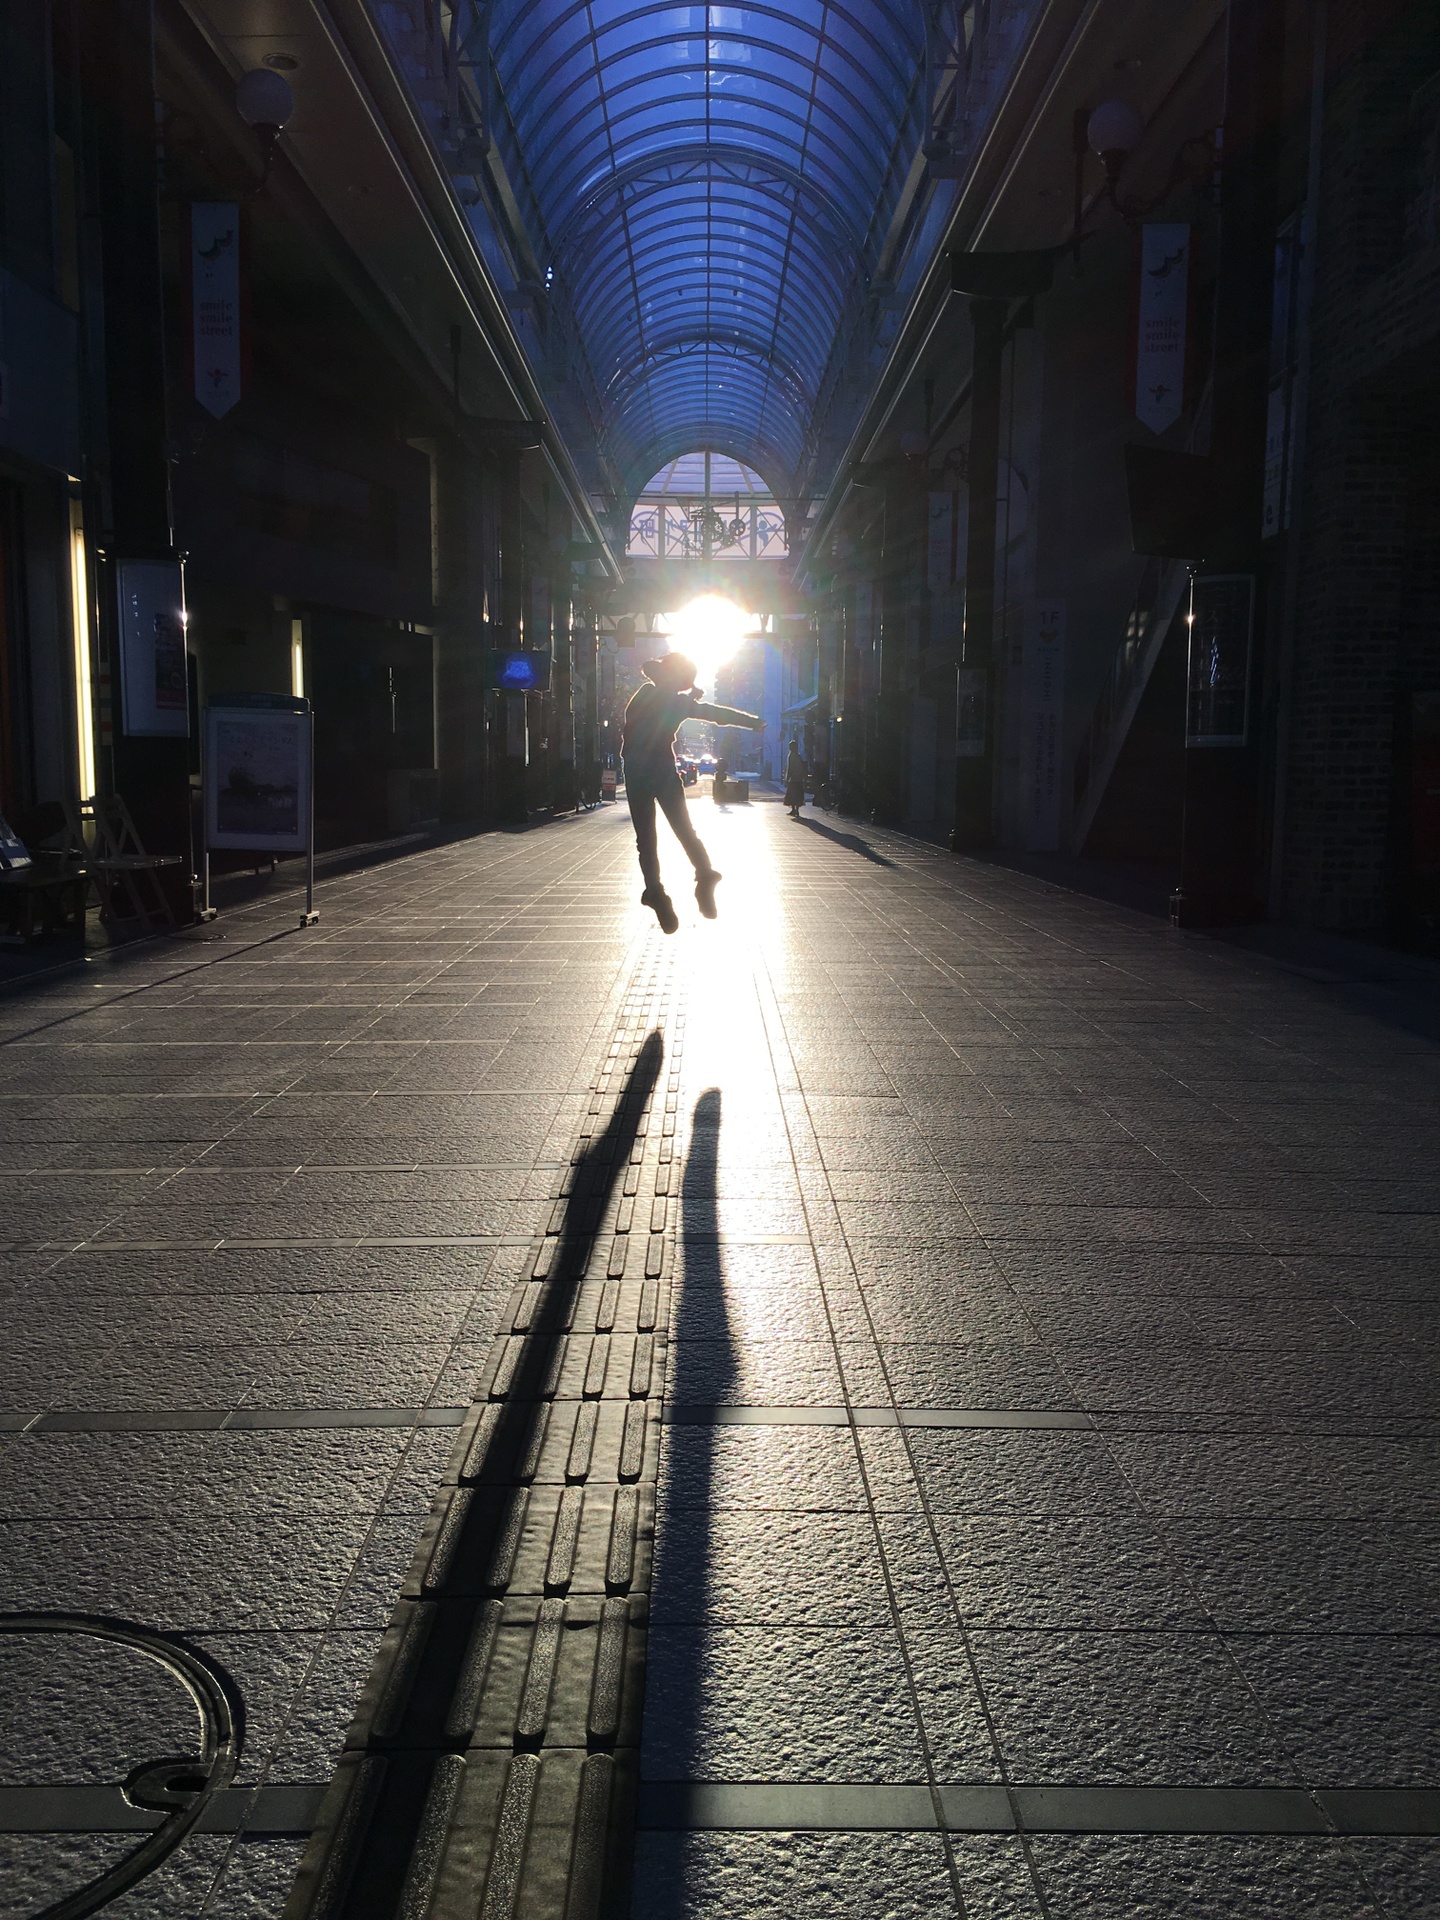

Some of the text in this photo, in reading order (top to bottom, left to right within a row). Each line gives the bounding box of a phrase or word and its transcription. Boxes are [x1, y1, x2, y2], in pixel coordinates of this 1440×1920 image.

[1145, 316, 1180, 328] smile
[199, 325, 233, 336] street
[1145, 328, 1180, 341] smile
[1144, 342, 1179, 353] street
[1040, 611, 1060, 624] 1F
